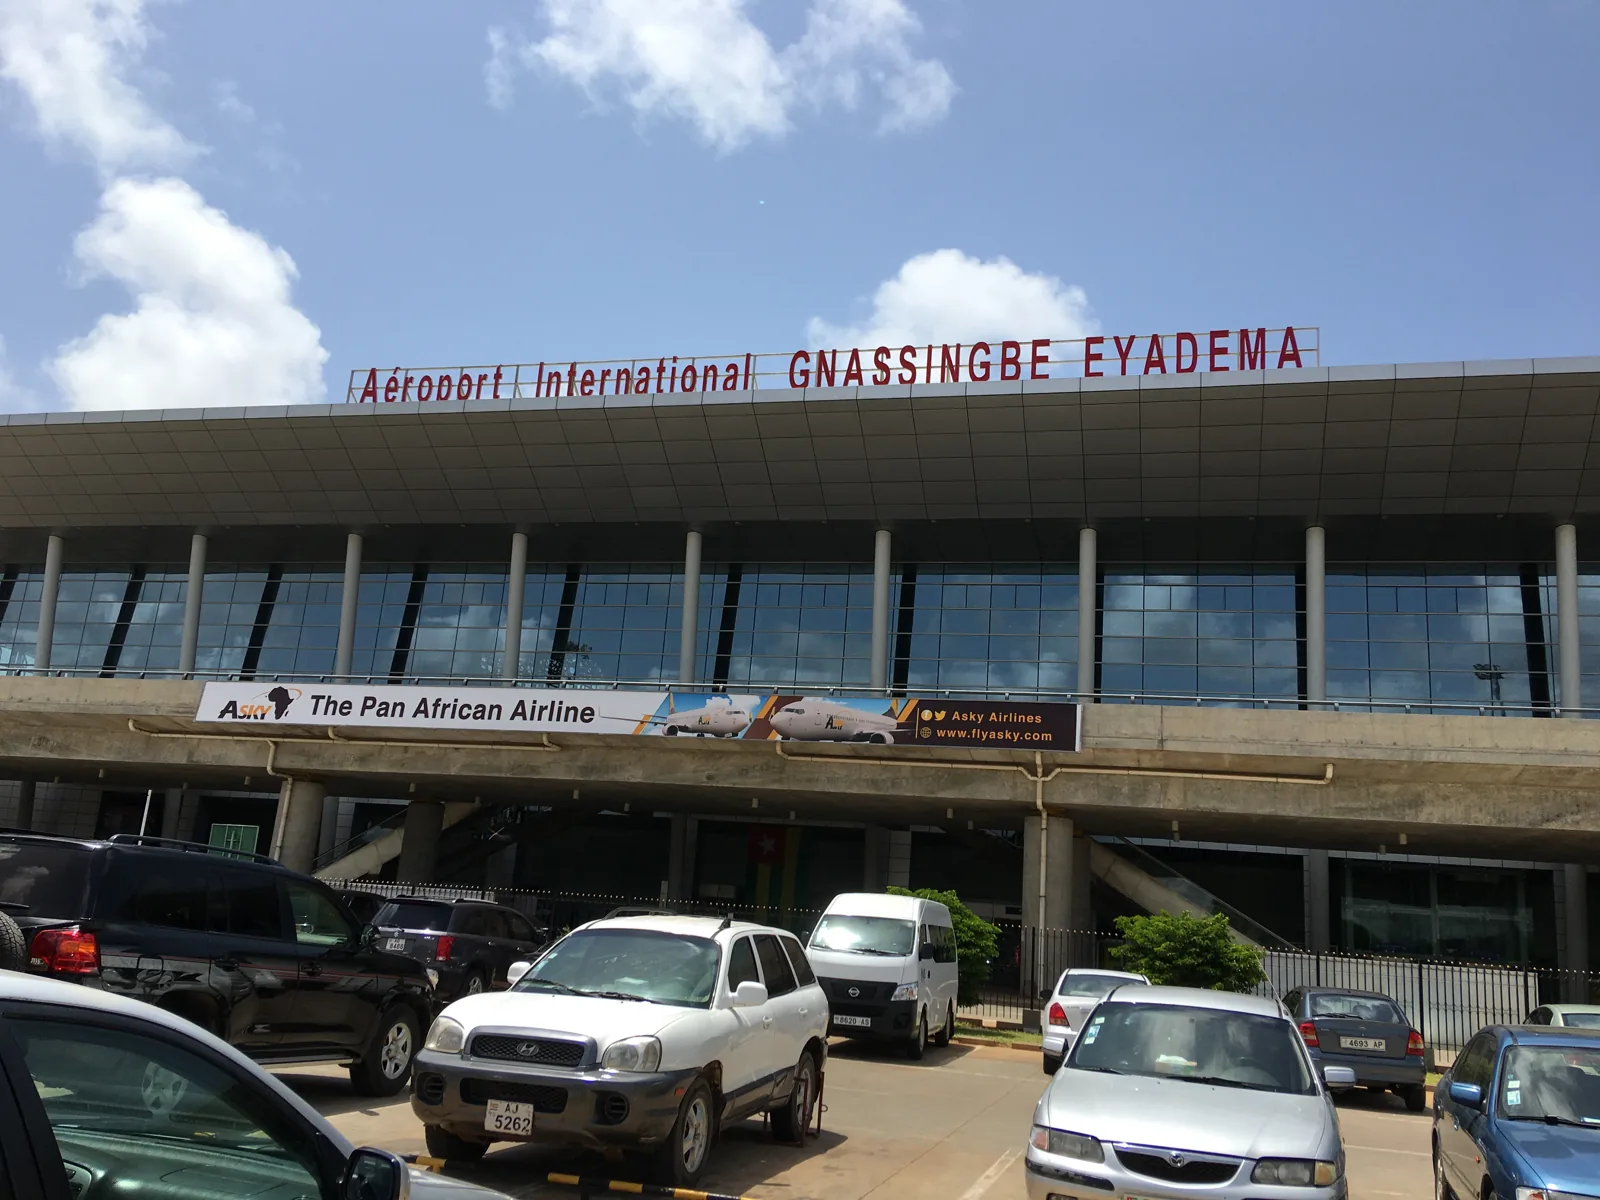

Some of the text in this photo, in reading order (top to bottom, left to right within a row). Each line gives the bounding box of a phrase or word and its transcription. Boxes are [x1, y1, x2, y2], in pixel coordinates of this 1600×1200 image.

[359, 326, 1303, 403] Aéroport International GNASSINGBE EYADEMA
[310, 694, 595, 724] The Pan African Airline
[952, 711, 1042, 724] Asky Airlines
[936, 728, 1053, 742] www.flyasky.com
[840, 1016, 857, 1025] 8620
[1349, 1039, 1383, 1049] 4693 AP
[504, 1103, 519, 1114] AJ
